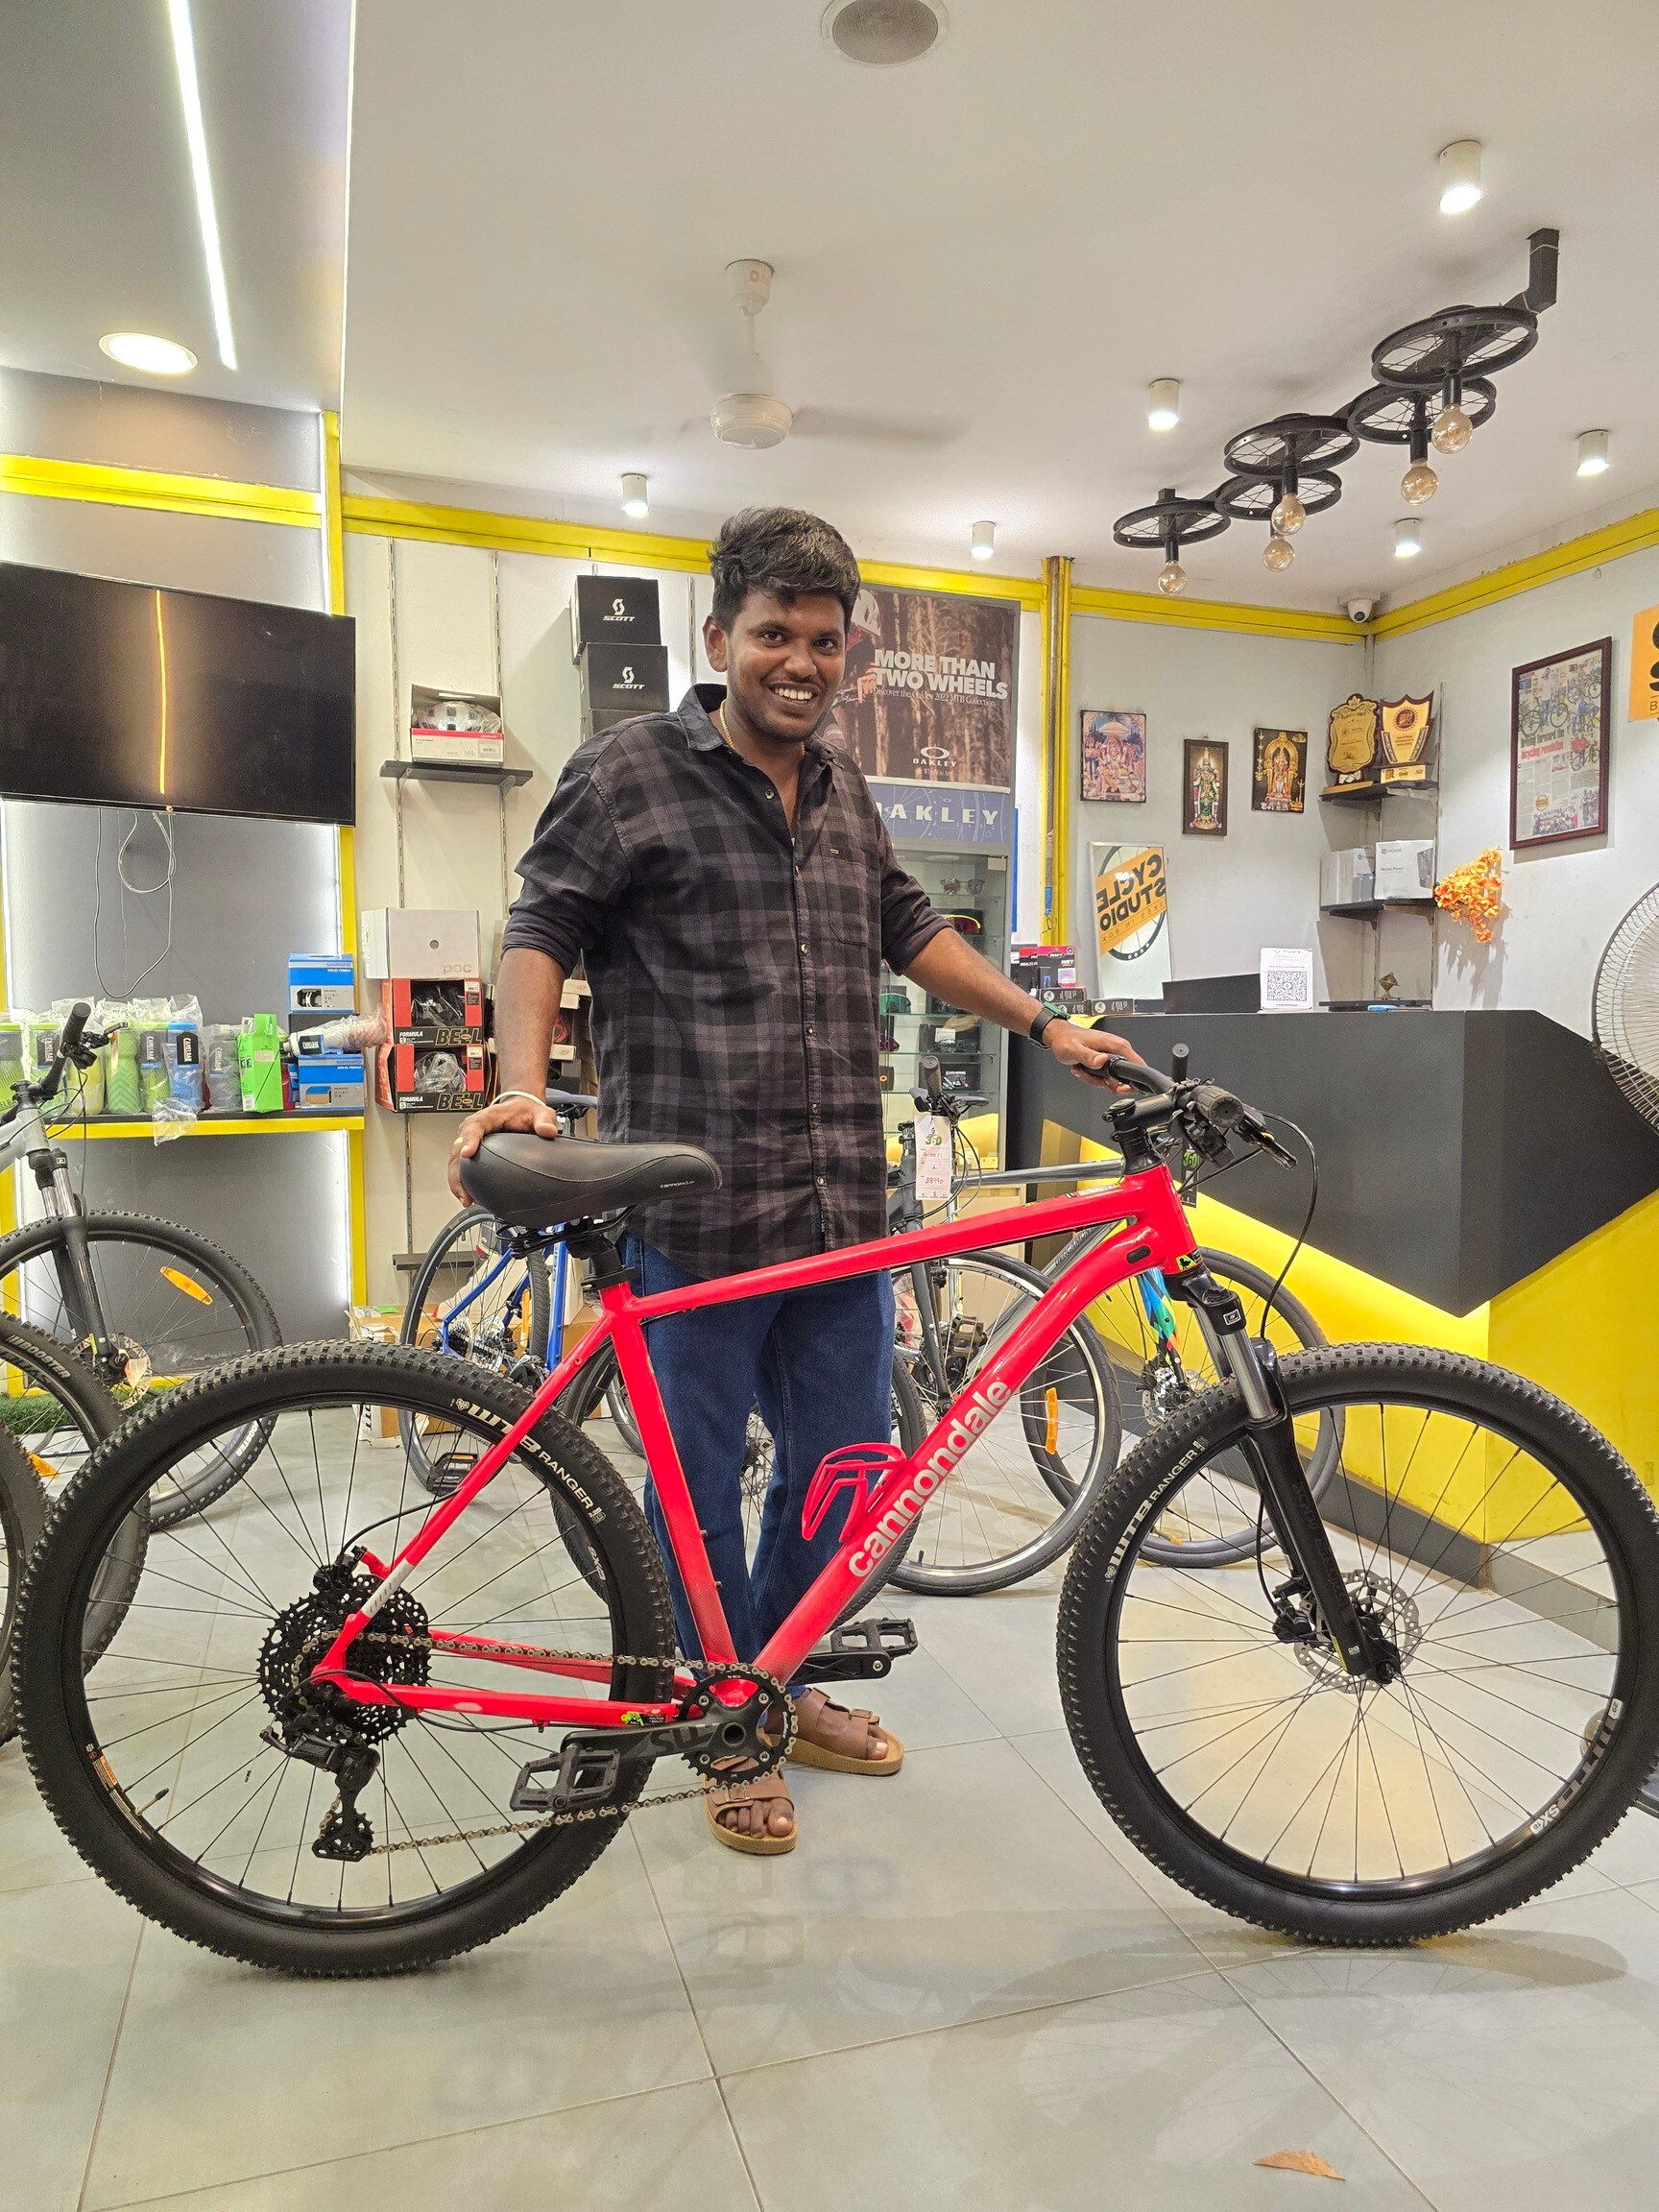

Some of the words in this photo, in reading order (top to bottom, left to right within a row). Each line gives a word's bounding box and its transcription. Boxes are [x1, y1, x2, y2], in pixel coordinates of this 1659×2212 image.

[875, 649, 936, 673] MORE
[939, 656, 996, 680] THAN
[873, 667, 924, 689] TWO
[927, 672, 1008, 700] WHEELS
[873, 687, 899, 697] Discover
[901, 689, 911, 698] the
[911, 689, 934, 701] Oakley
[934, 692, 950, 702] 2022
[950, 694, 965, 704] MTB
[965, 696, 996, 708] Collection
[913, 757, 957, 767] OAKLEY
[146, 1035, 155, 1061] CAMELBAK
[182, 1037, 192, 1063] CAMELBAK
[435, 1028, 482, 1046] BELL
[437, 1094, 483, 1111] BELL
[1183, 1151, 1199, 1168] 360
[467, 1403, 541, 1454] WTB
[538, 1451, 595, 1510] RANGER
[849, 1380, 1012, 1578] cannondale
[1109, 1499, 1153, 1567] WTB
[1148, 1449, 1198, 1501] RANGER
